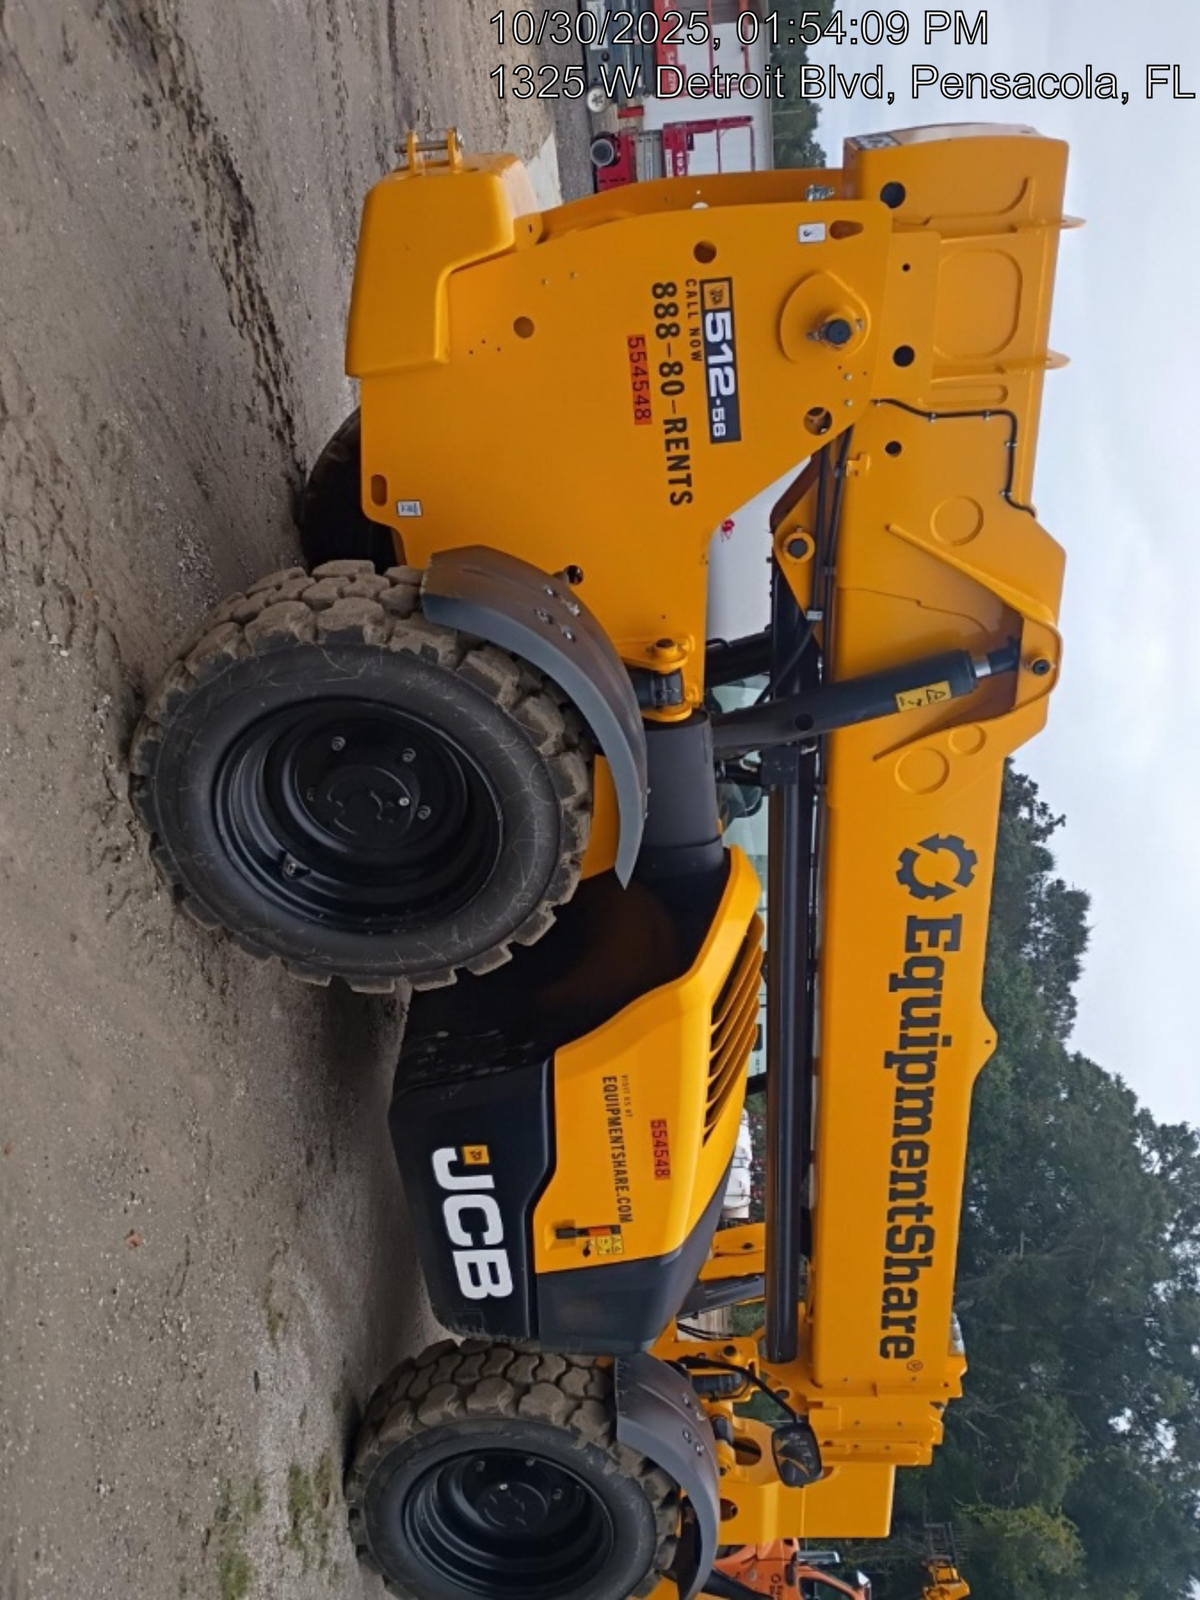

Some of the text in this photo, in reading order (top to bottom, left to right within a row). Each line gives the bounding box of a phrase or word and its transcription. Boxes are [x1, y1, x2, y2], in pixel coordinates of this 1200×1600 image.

[628, 336, 651, 421] 554548
[685, 278, 703, 363] CALL NOW
[705, 311, 734, 438] 512-56
[651, 281, 694, 507] 888-80-RENTS
[602, 1076, 634, 1224] EQUIPMENTSHARE.COM
[650, 1120, 671, 1178] 554548
[879, 914, 963, 1360] EquipmentShare
[431, 1146, 514, 1300] JCB
